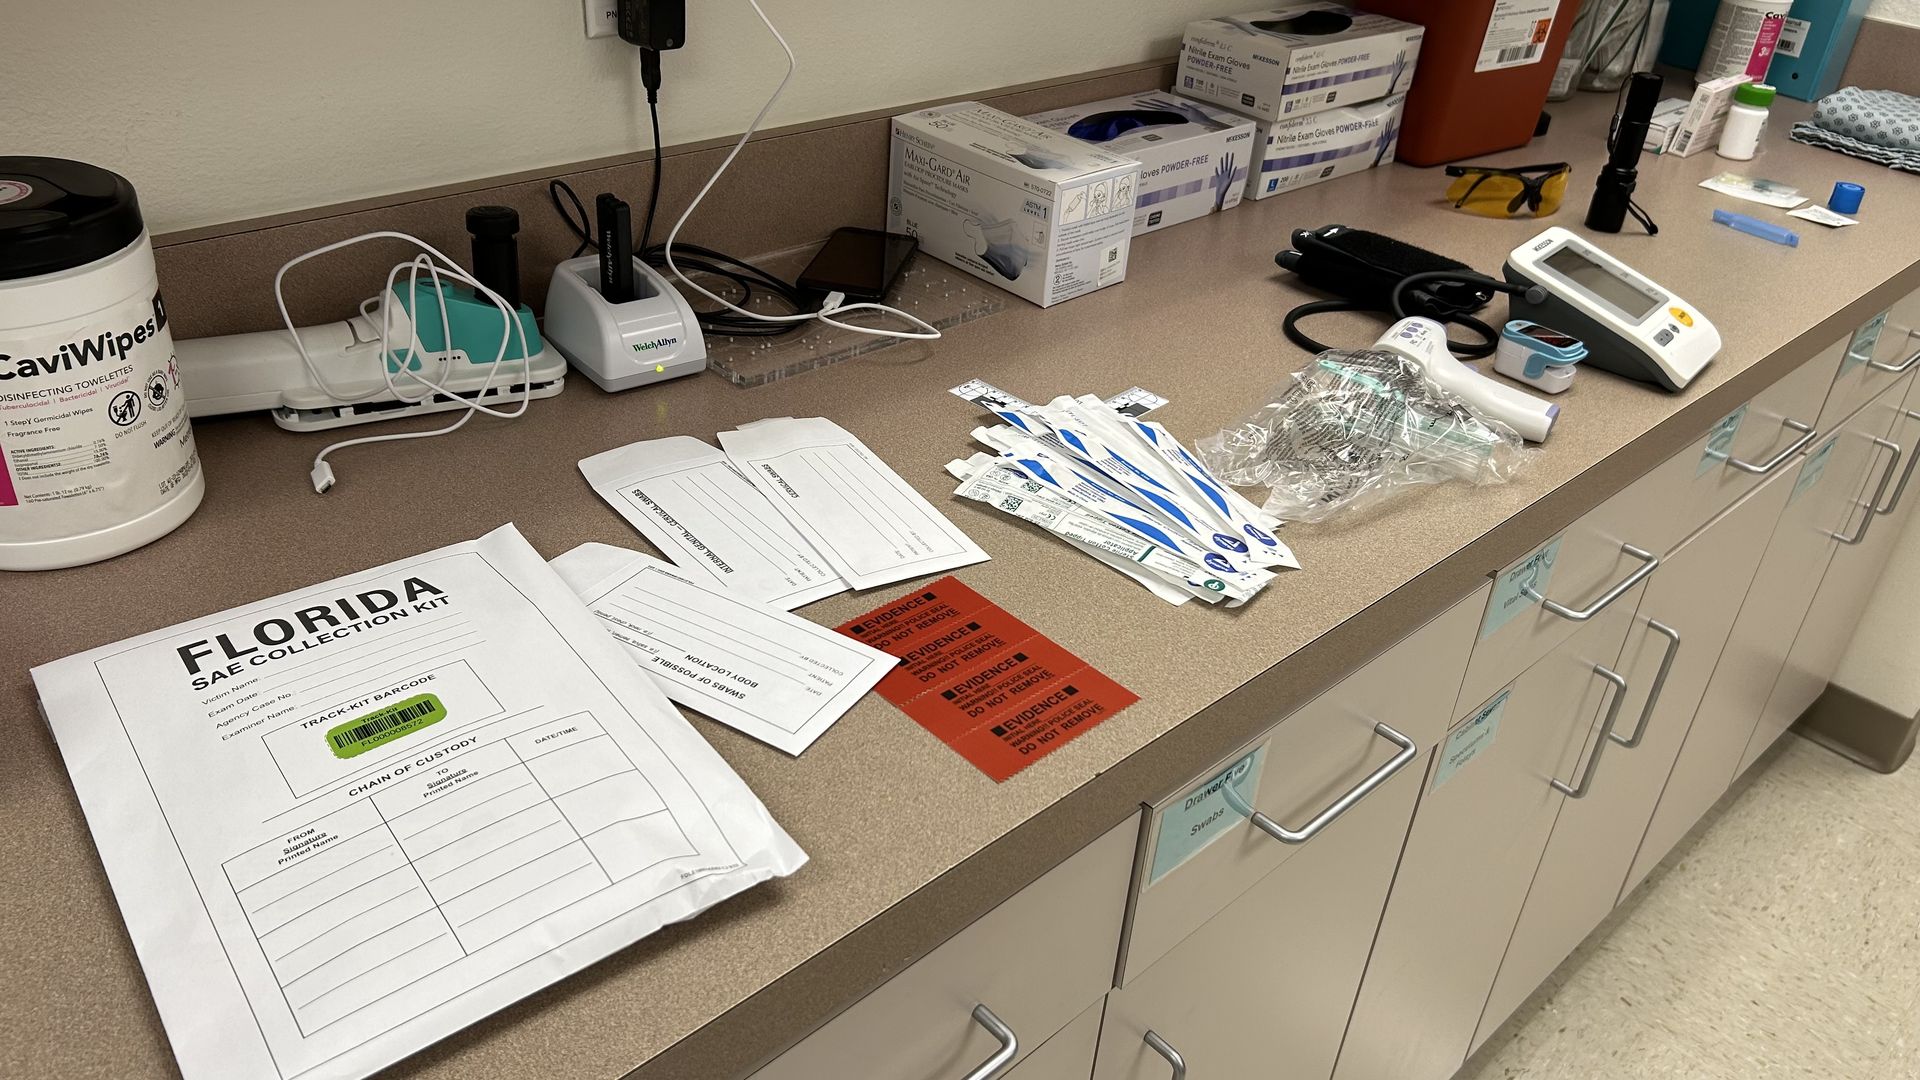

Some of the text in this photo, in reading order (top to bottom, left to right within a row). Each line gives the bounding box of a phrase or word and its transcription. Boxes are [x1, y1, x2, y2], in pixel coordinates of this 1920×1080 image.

[1187, 55, 1233, 75] POWDER-FREE
[1188, 45, 1250, 70] Nitrile Exam Gloves
[1292, 64, 1306, 75] Nitrile
[1307, 61, 1321, 73] Exam
[1321, 58, 1337, 71] Gloves
[1336, 52, 1371, 65] POWDER-FREE
[1276, 119, 1379, 145] Nitrile Exam Gloves POWDER-FREE
[1160, 154, 1209, 174] POWDER-FREE
[1025, 200, 1048, 219] ASTM 1
[906, 218, 918, 230] BLUE
[0, 317, 155, 381] CaviWipes
[59, 389, 98, 403] Bactericidal
[104, 376, 130, 391] Virucidal
[74, 364, 134, 391] TOWELETTES
[33, 412, 72, 424] Germicidal
[72, 407, 94, 417] Wipes
[6, 425, 61, 438] Fragrance Free
[114, 419, 147, 440] DO NOT FLUSH
[153, 428, 176, 449] WARNING
[761, 463, 780, 479] SWABS
[775, 477, 800, 499] CERVICAL
[631, 488, 735, 575] INTERNAL GENITAL CERVICAL SWABS
[1064, 531, 1087, 542] Tipped
[1088, 539, 1111, 551] Cotton
[1102, 540, 1138, 556] Applicator
[1509, 558, 1536, 583] Drawer
[861, 595, 927, 630] EVIDENCE
[904, 603, 950, 626] POLICE SEAL
[175, 576, 444, 676] FLORIDA
[874, 607, 958, 651] DO NOT REMOVE
[191, 594, 450, 691] SAE COLLECTION KIT
[906, 626, 971, 662] EVIDENCE
[948, 632, 995, 658] POLICE SEAL
[684, 653, 759, 690] BODY LOCATION
[808, 658, 844, 677] COLLECTED
[918, 637, 1003, 683] DO NOT REMOVE
[651, 655, 747, 700] SWABS OF POSSIBLE
[807, 672, 834, 687] PATIENT
[953, 658, 1018, 695] EVIDENCE
[996, 664, 1043, 692] POLICE SEAL
[201, 690, 230, 706] Victim
[299, 673, 437, 731] TRACK-KIT BARCODE
[805, 687, 823, 697] DATE
[966, 669, 1052, 719] DO NOT REMOVE
[207, 703, 235, 718] Exam
[216, 710, 250, 730] Agency
[251, 698, 276, 712] Case
[361, 707, 398, 723] Track-Kit
[1002, 690, 1068, 731] EVIDENCE
[1047, 698, 1094, 727] POLICE SEAL
[221, 718, 265, 742] Examiner
[534, 725, 579, 745] DATE/TIME
[1018, 703, 1105, 756] DO NOT REMOVE
[348, 735, 479, 797] CHAIN OF CUSTODY
[426, 767, 468, 790] Signature
[436, 767, 450, 777] TO
[423, 769, 480, 799] Printed Name
[1184, 764, 1246, 812] Drawer Five
[1190, 807, 1225, 837] Swabs
[282, 831, 328, 856] Signature
[286, 827, 316, 845] FROM
[277, 833, 340, 866] Printed Name
